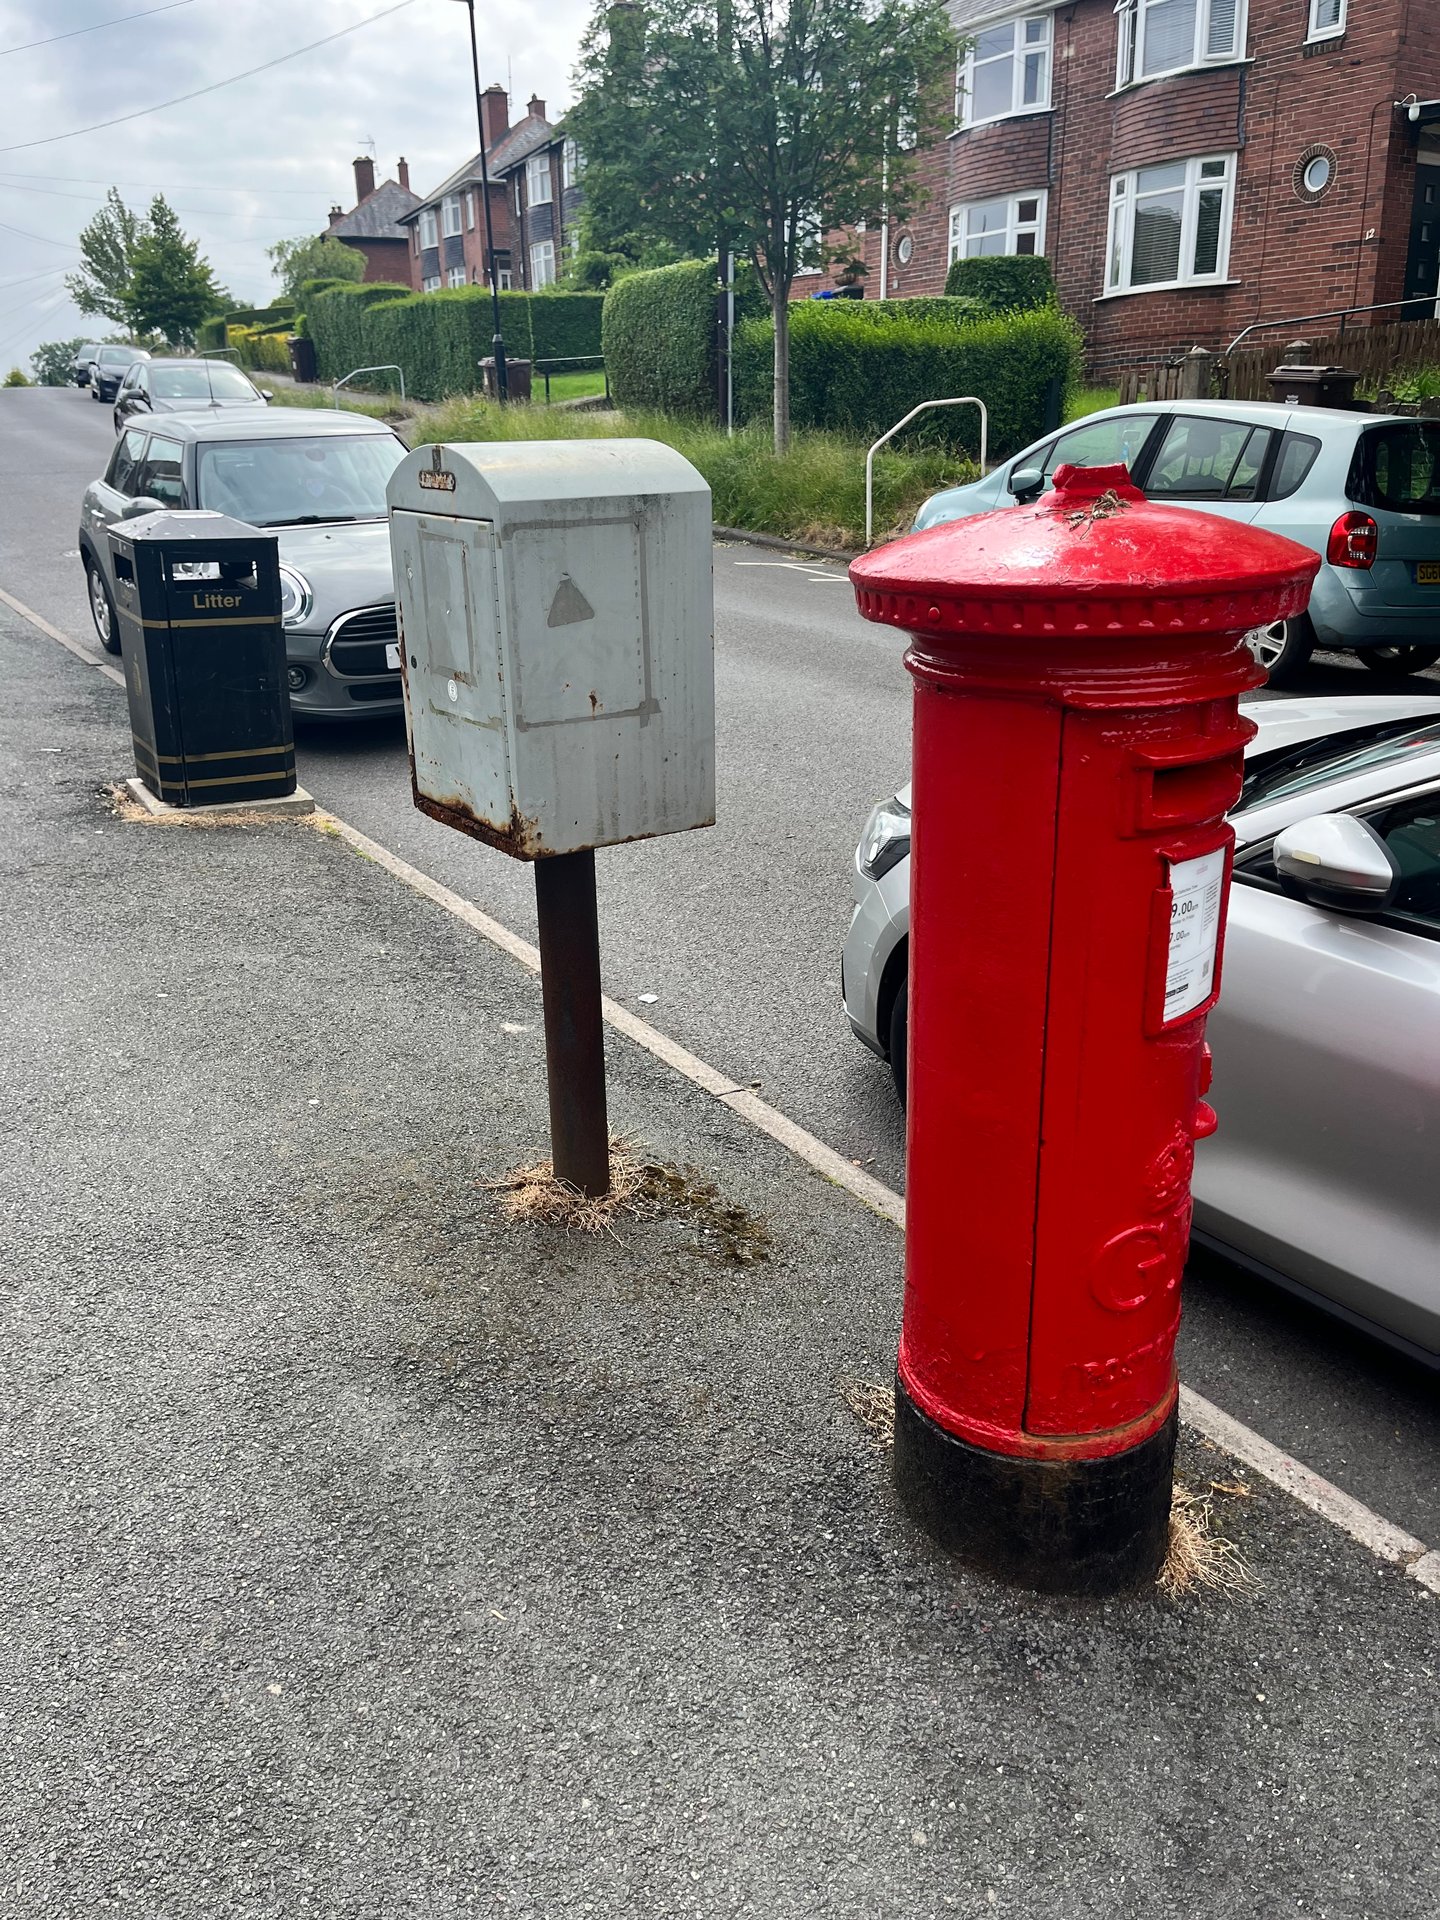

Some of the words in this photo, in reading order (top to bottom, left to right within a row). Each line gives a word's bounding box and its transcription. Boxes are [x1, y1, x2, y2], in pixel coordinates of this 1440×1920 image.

[1365, 228, 1375, 241] 12
[1420, 564, 1440, 580] SG6
[193, 593, 243, 609] Litter
